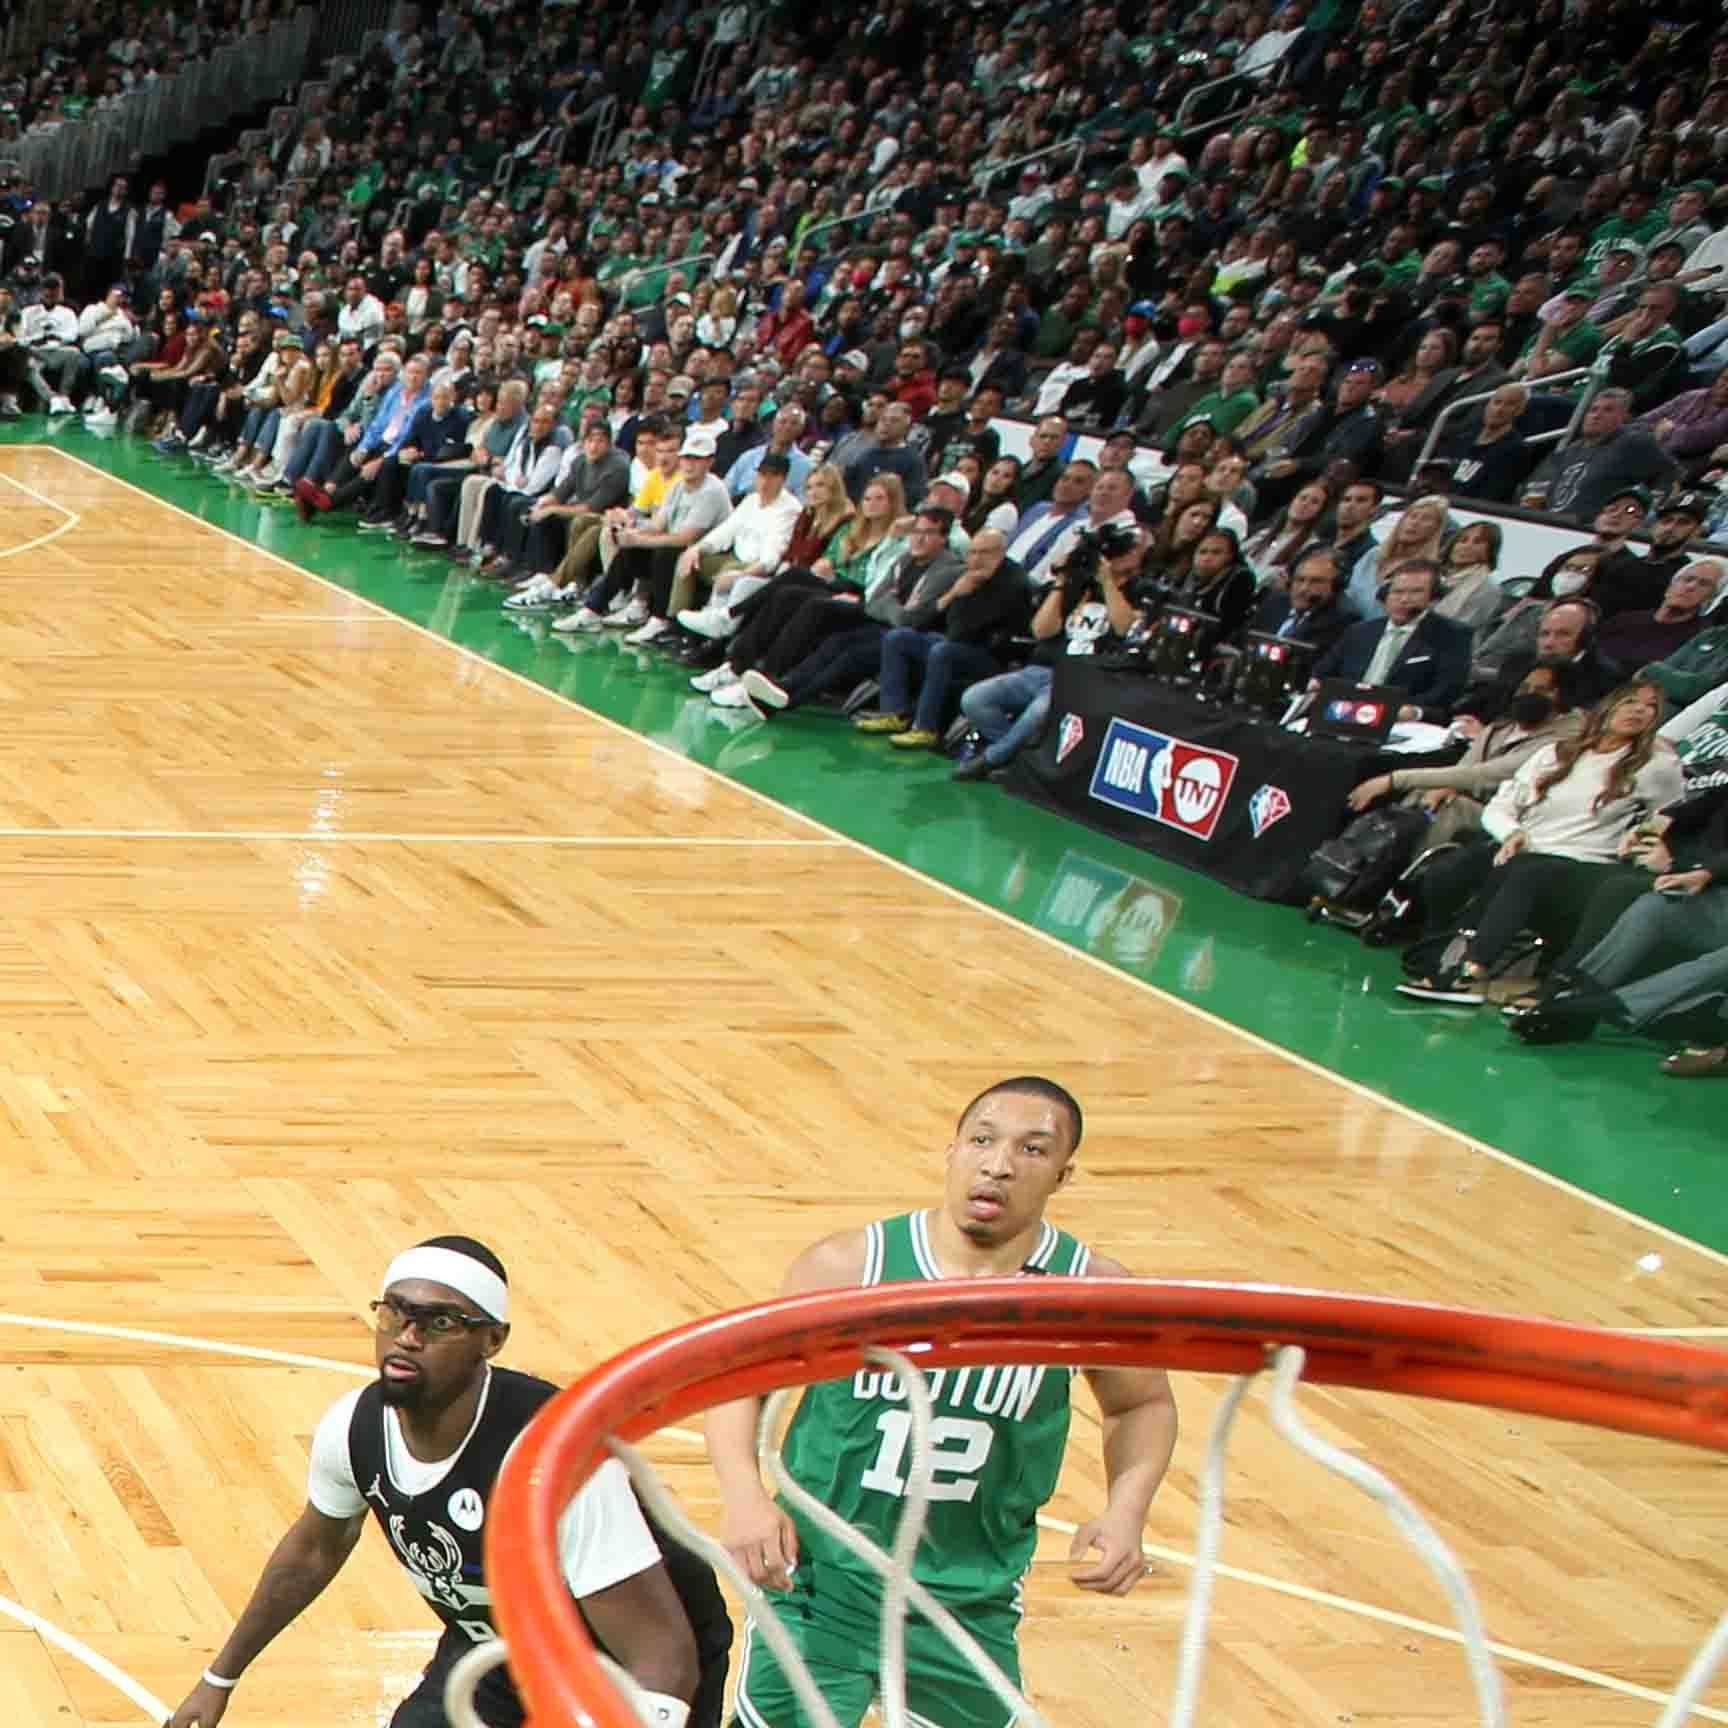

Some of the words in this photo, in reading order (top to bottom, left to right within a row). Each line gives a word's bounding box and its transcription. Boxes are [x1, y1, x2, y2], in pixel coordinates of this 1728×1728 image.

[1103, 736, 1149, 795] NBA
[1173, 774, 1220, 812] TNT
[860, 1408, 995, 1503] 12
